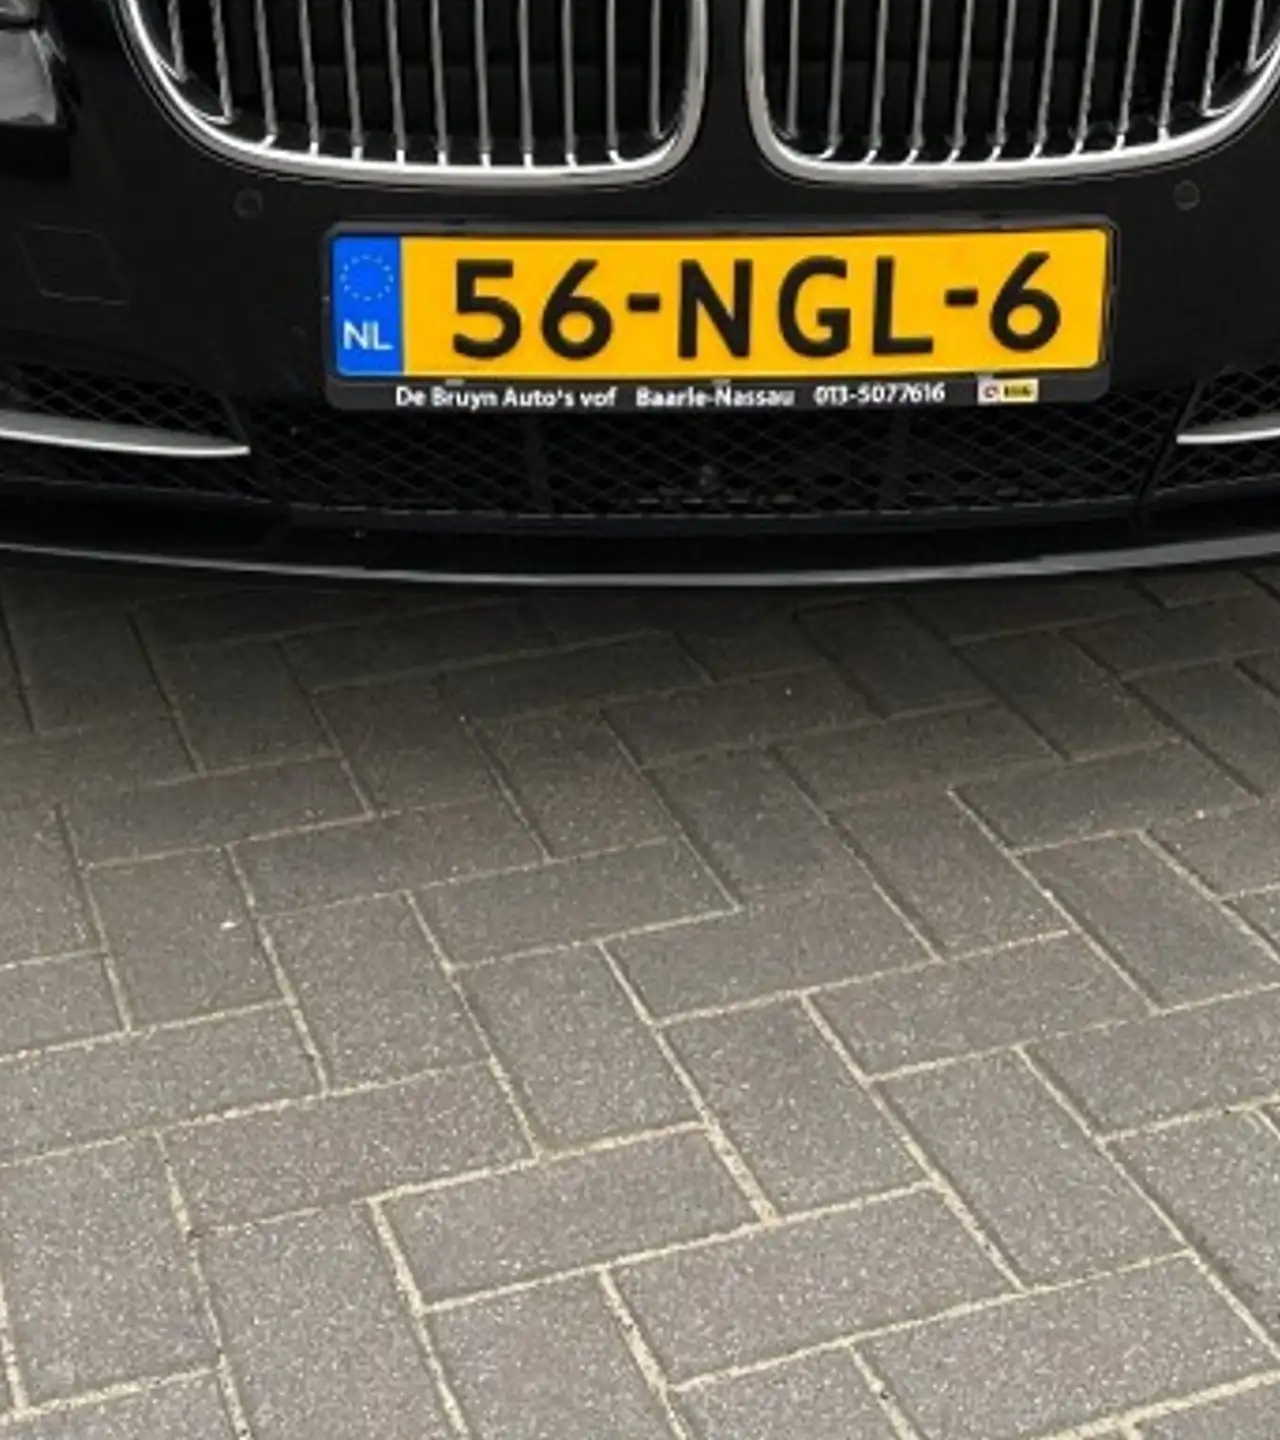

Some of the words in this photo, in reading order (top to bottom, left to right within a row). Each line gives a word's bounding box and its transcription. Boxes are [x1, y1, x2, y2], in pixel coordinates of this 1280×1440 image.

[452, 251, 1062, 361] 56-NGL-6
[343, 320, 394, 351] NL
[395, 385, 425, 407] De
[431, 385, 498, 411] Bruyn
[502, 386, 574, 407] Auto's
[580, 385, 617, 407] vof
[635, 384, 795, 407] Baarle-Nassau
[813, 381, 946, 406] 013-5077616
